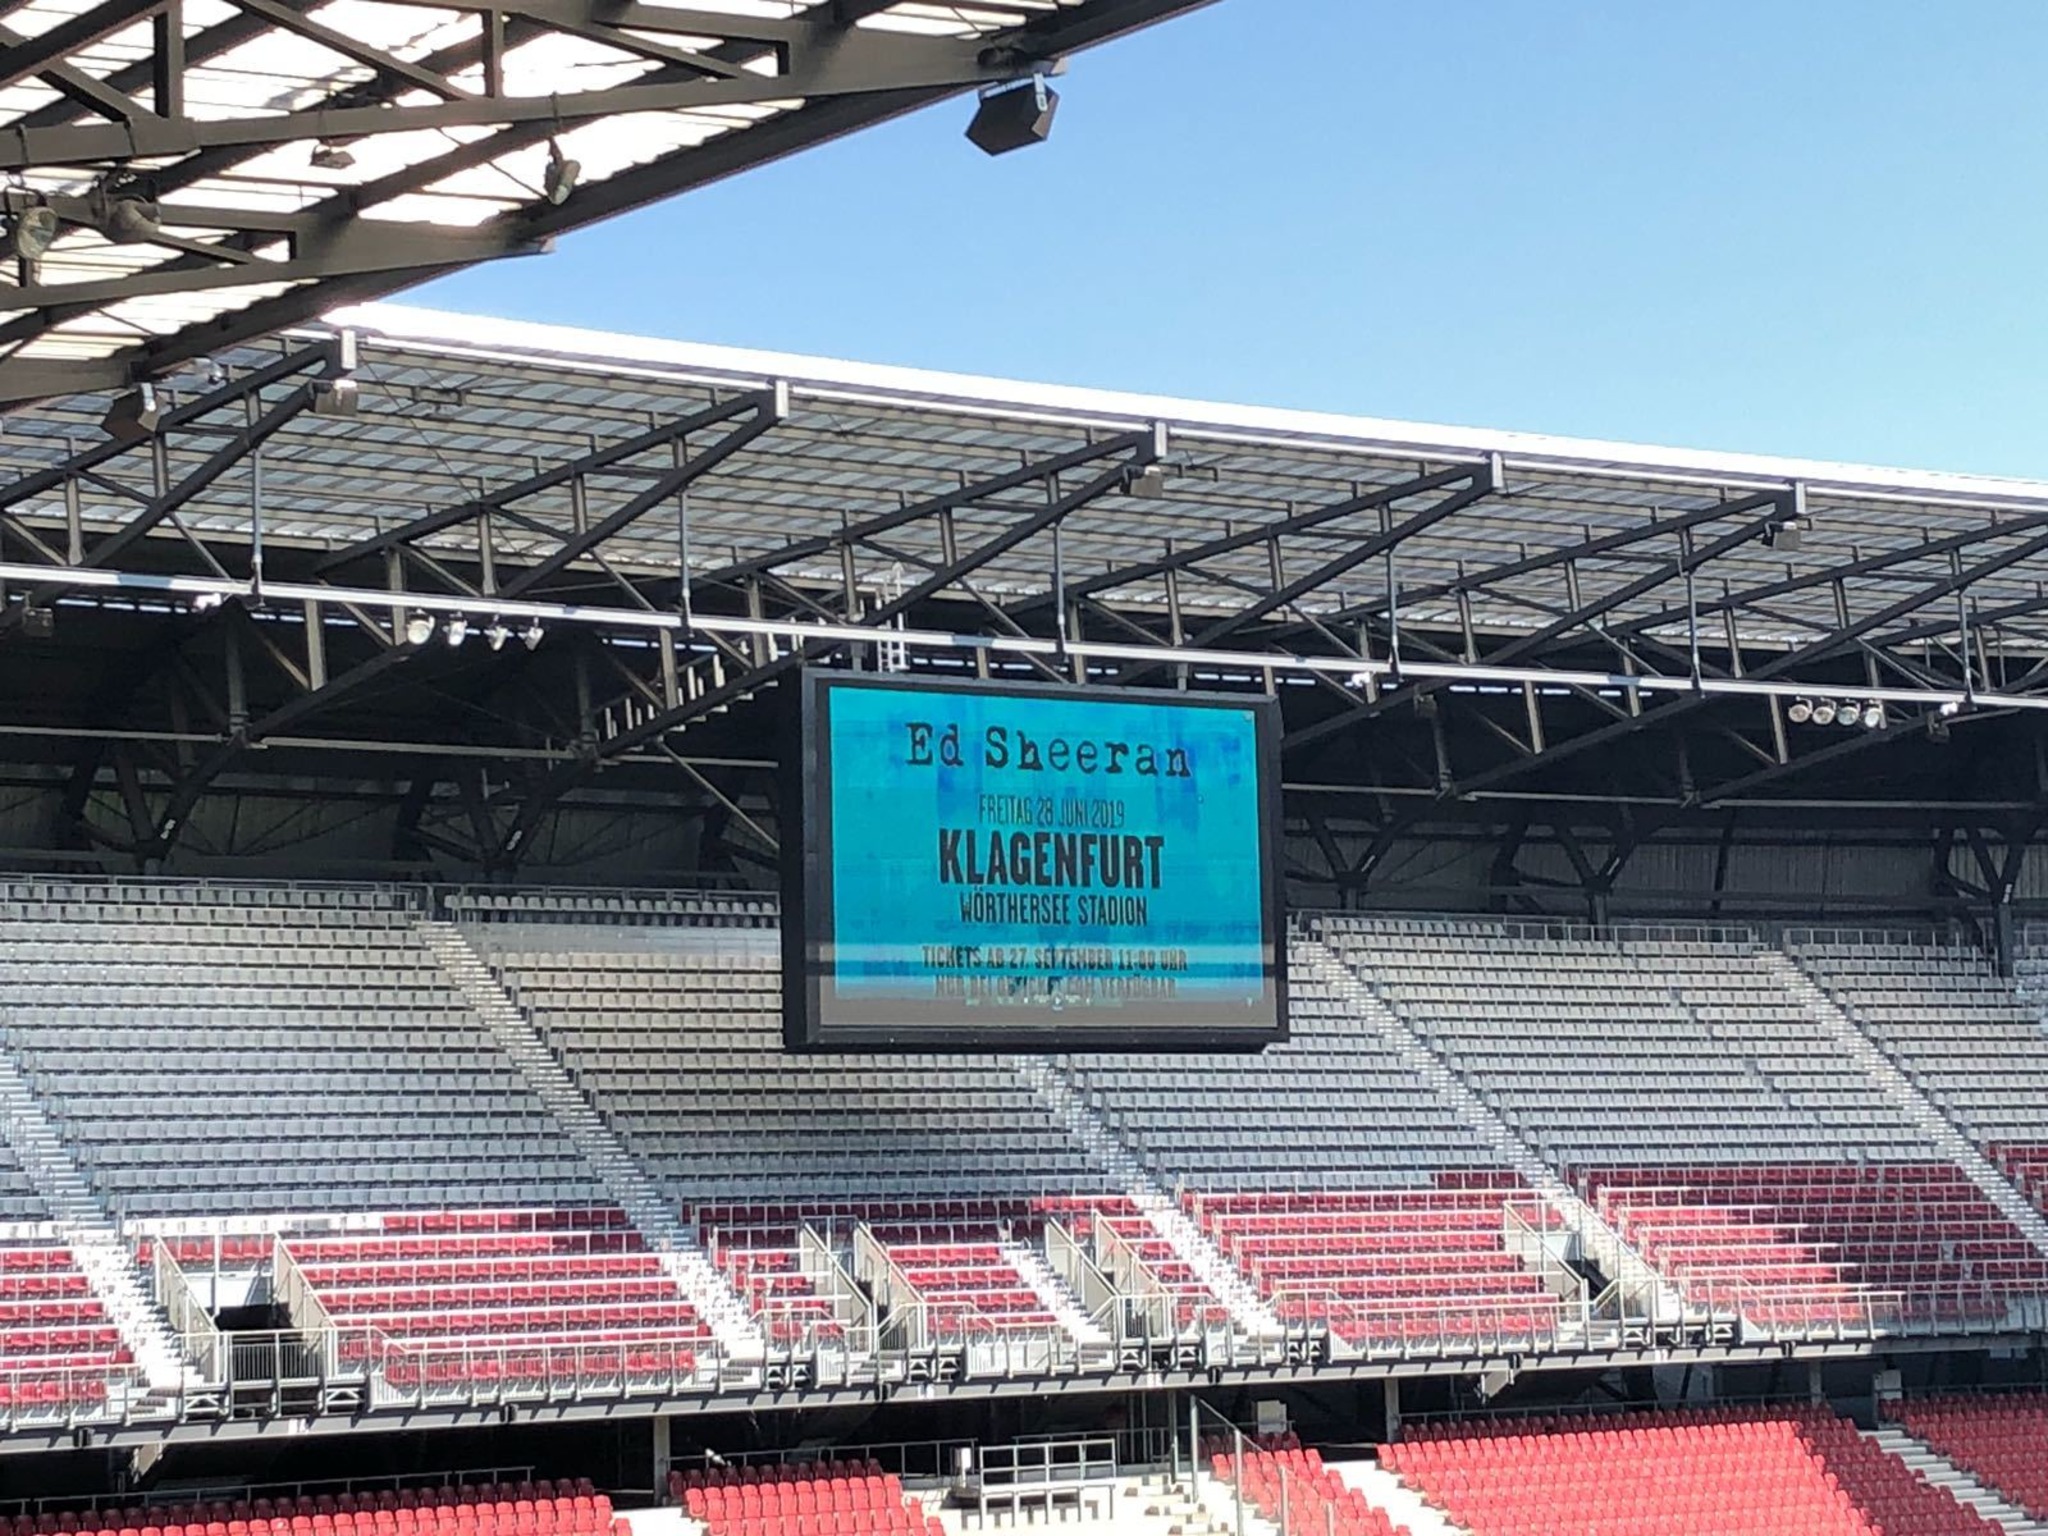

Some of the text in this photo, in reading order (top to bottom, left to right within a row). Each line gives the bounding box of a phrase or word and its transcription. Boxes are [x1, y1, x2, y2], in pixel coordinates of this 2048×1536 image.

[905, 722, 1192, 778] Ed Sheeran
[979, 794, 1126, 829] FREITAG 28 JUNI 2019
[938, 828, 1165, 889] KLAGENFURT
[960, 887, 1148, 926] WÖRTHERSEE STADION
[921, 945, 981, 968] TICKETS
[986, 945, 1005, 968] AB
[1034, 945, 1114, 970] SEPTEMBER
[1160, 948, 1189, 971] UHR
